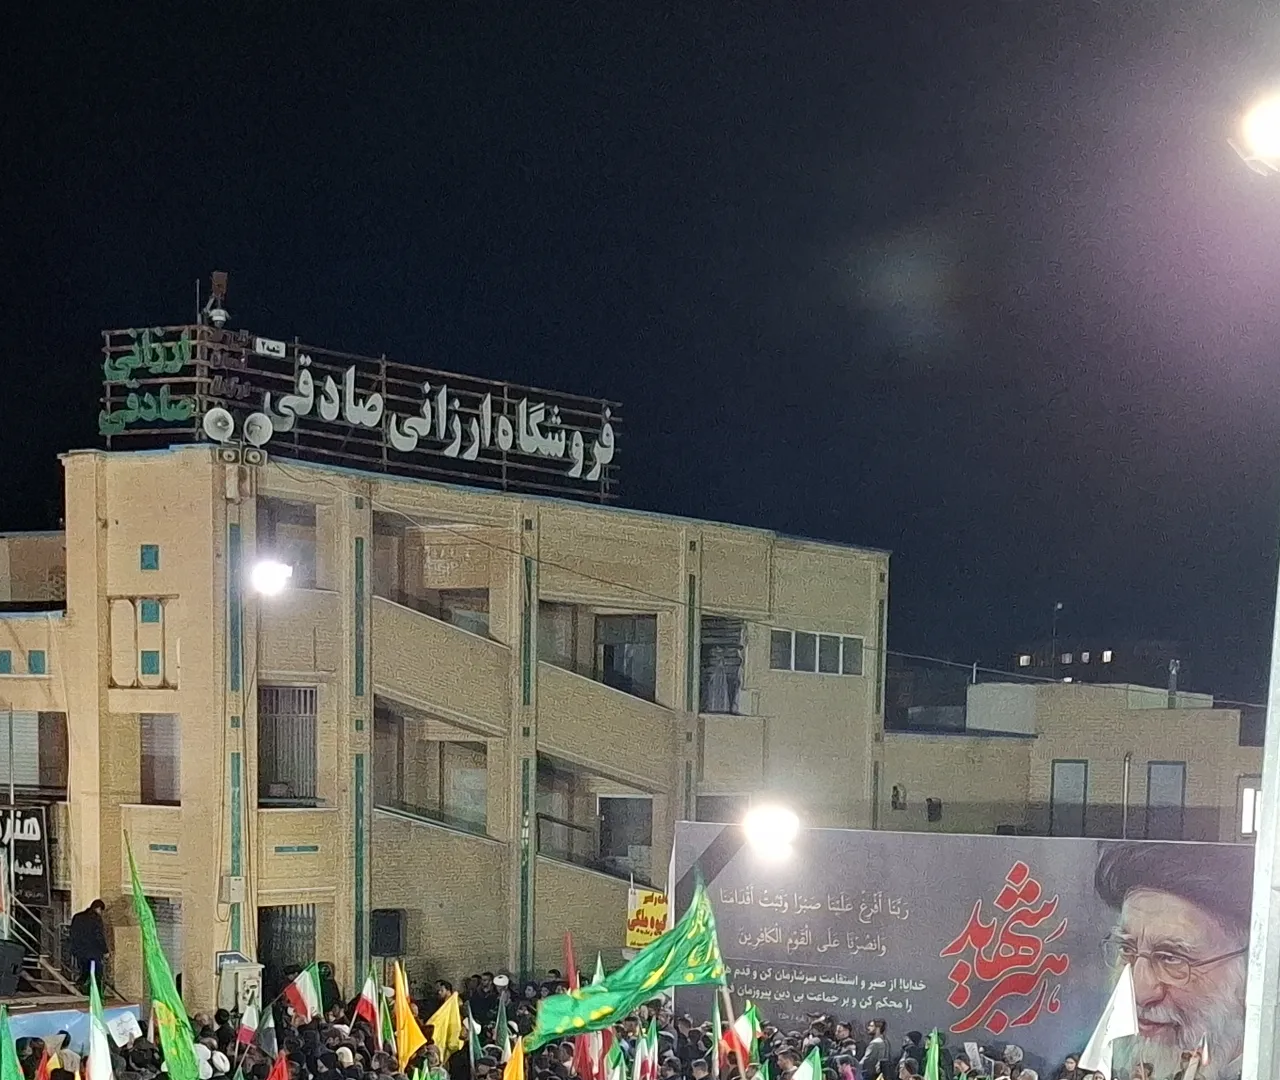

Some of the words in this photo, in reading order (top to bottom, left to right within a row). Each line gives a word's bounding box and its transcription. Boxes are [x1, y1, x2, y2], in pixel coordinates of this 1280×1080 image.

[104, 326, 190, 380] ارزانی
[264, 355, 384, 431] صادقی
[99, 378, 194, 433] صادقی
[390, 381, 491, 460] ارزانی
[499, 398, 615, 480] فروشگاه
[13, 854, 43, 880] شعب
[940, 860, 1058, 1009] شهید
[733, 966, 751, 978] قدم
[752, 970, 757, 980] و
[759, 968, 772, 981] کن
[774, 969, 817, 984] سرشارمان
[819, 974, 859, 987] استقامت
[860, 981, 865, 990] و
[868, 978, 887, 991] صبر
[888, 977, 897, 990] از
[899, 978, 927, 991] خدایا!
[737, 985, 773, 1002] پیروزمان
[774, 990, 791, 1002] دین
[793, 991, 805, 1003] بی
[807, 991, 839, 1005] جماعت
[950, 952, 1070, 1035] رهبر
[840, 996, 850, 1007] بر
[852, 999, 857, 1007] و
[859, 995, 873, 1008] کن
[875, 999, 903, 1011] محکم
[905, 999, 913, 1012] را
